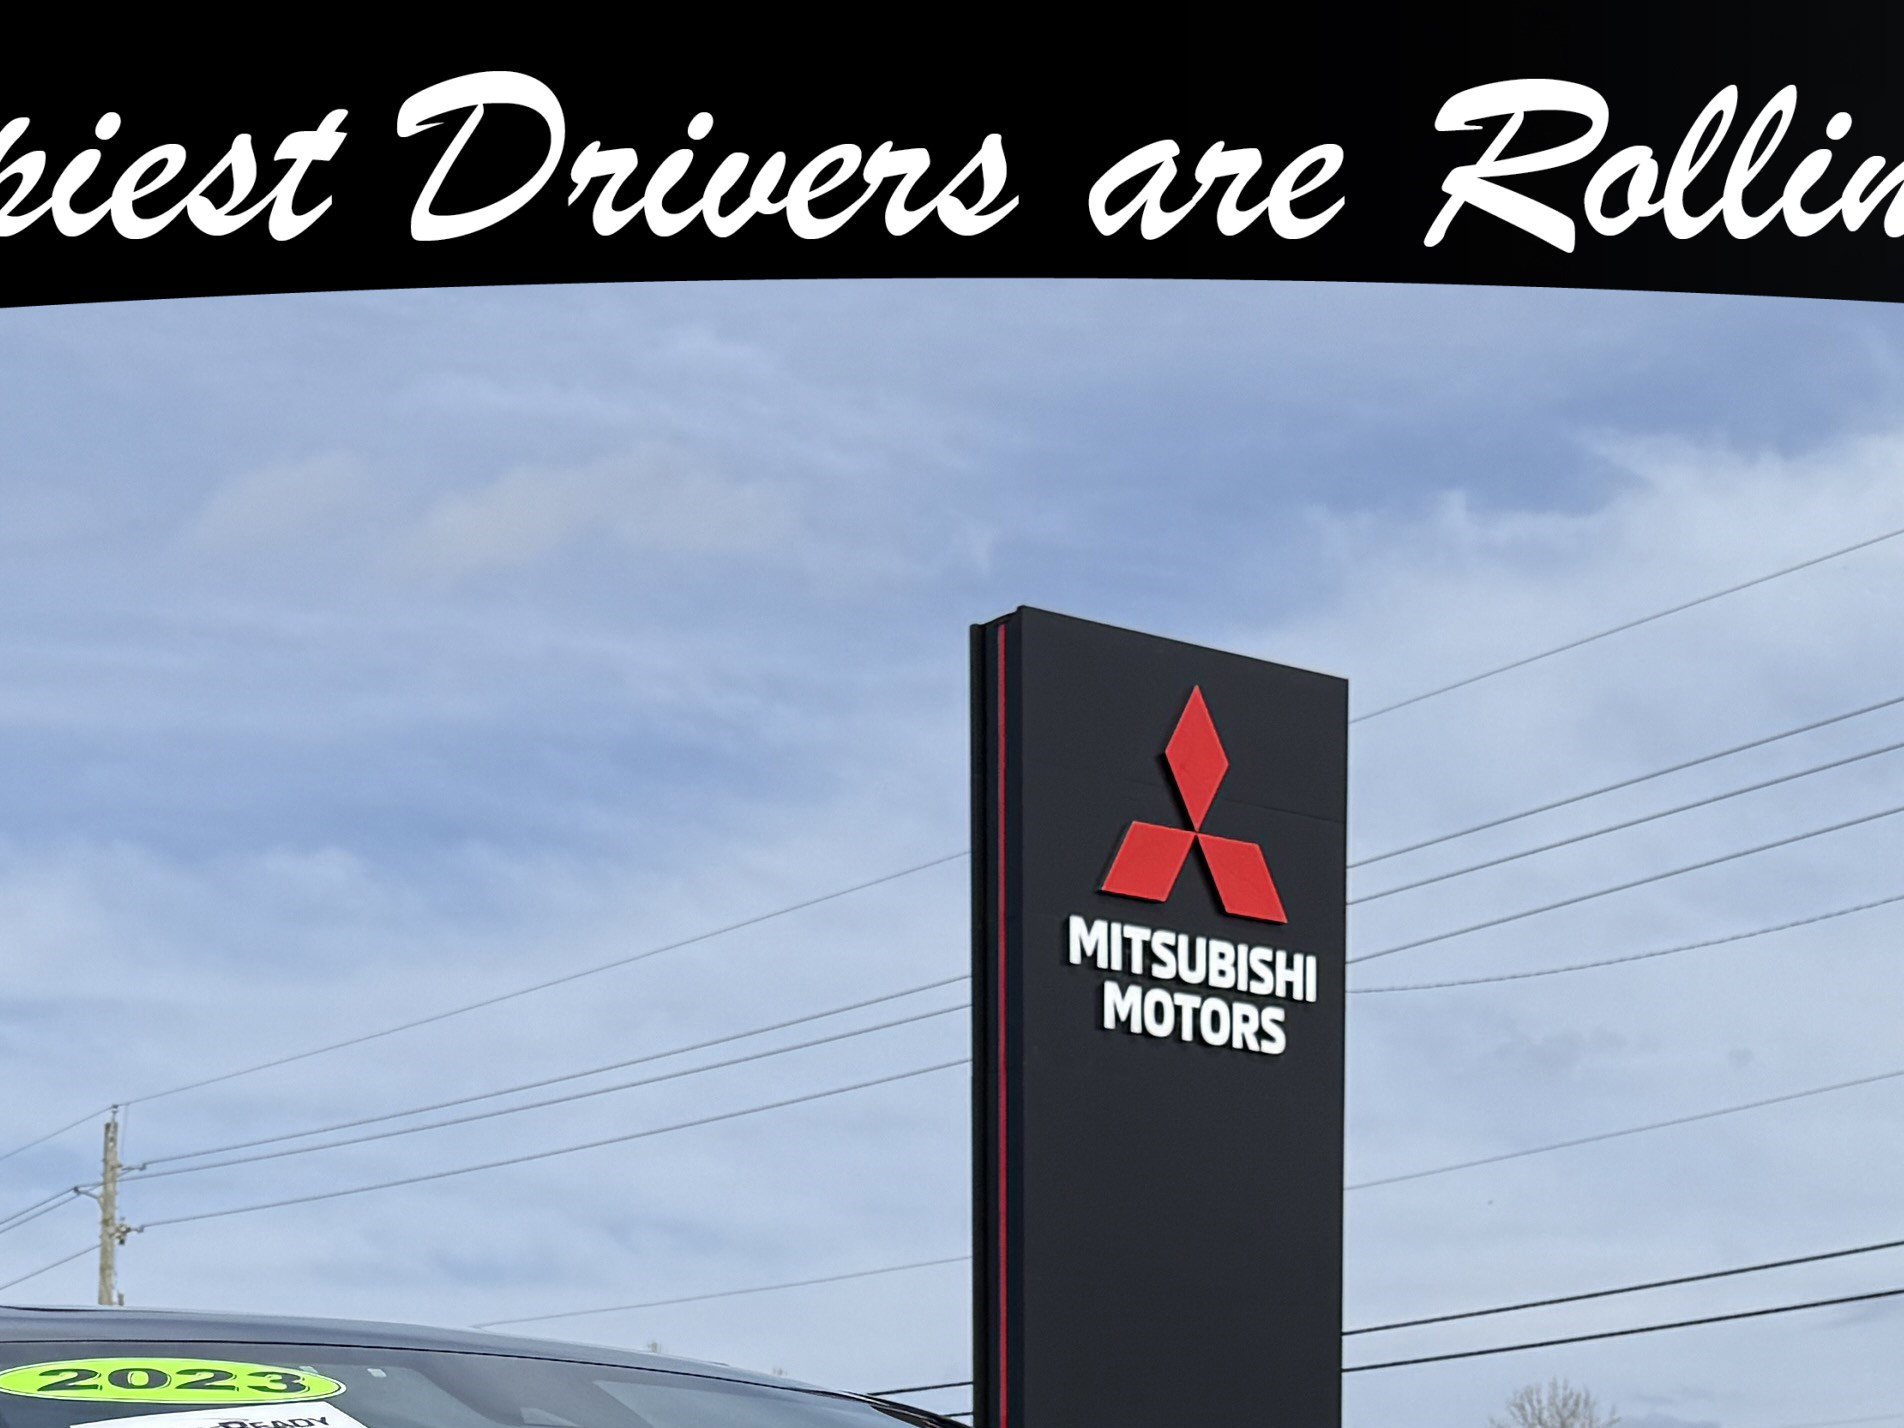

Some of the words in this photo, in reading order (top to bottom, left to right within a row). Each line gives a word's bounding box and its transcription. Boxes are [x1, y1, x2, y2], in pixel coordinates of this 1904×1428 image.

[1069, 914, 1317, 1003] MITSUBISHI
[1103, 980, 1287, 1055] MOTORS
[37, 1367, 312, 1395] 2023
